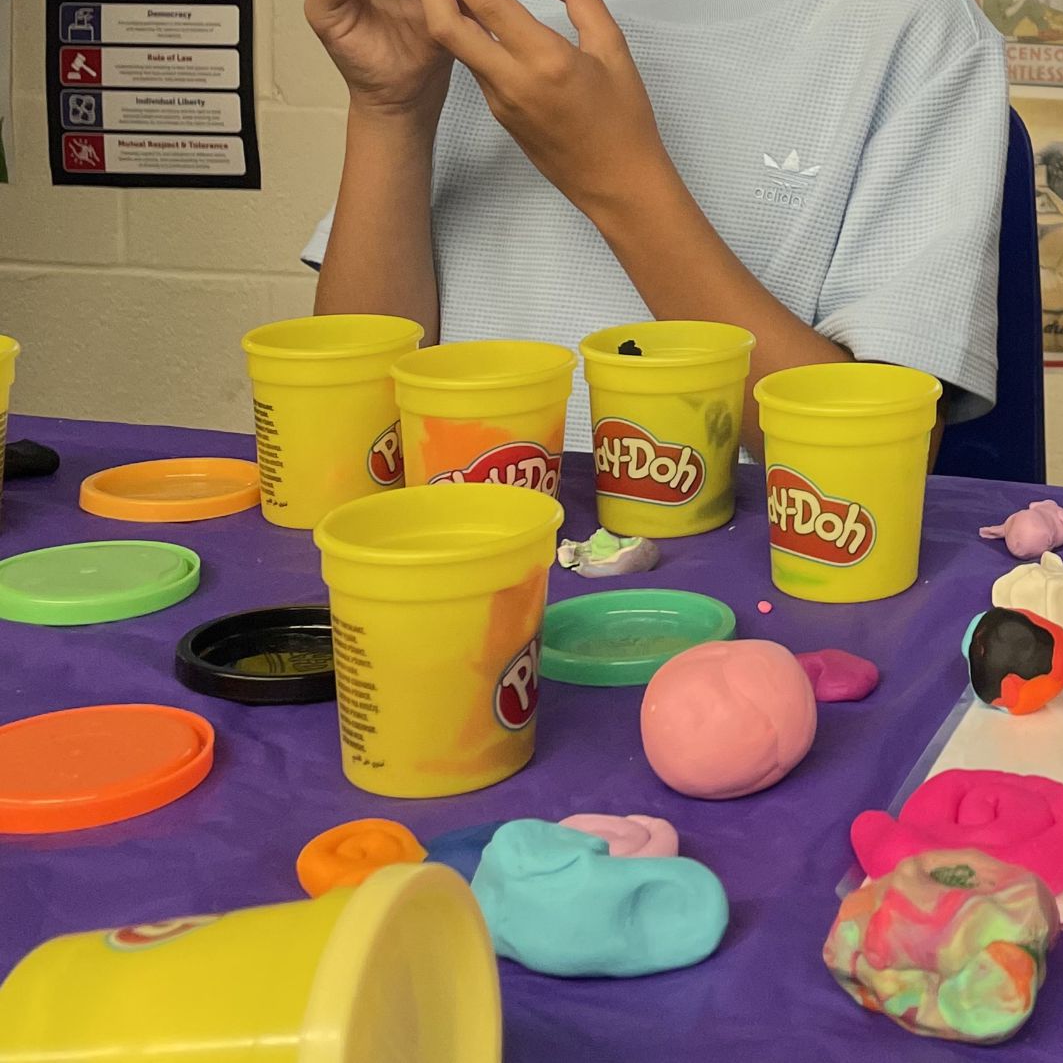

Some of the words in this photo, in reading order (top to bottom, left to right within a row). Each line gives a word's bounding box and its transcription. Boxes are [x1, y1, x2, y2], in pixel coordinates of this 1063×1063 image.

[147, 9, 192, 20] Democracy
[136, 96, 176, 106] Individual
[177, 97, 206, 108] Liberty
